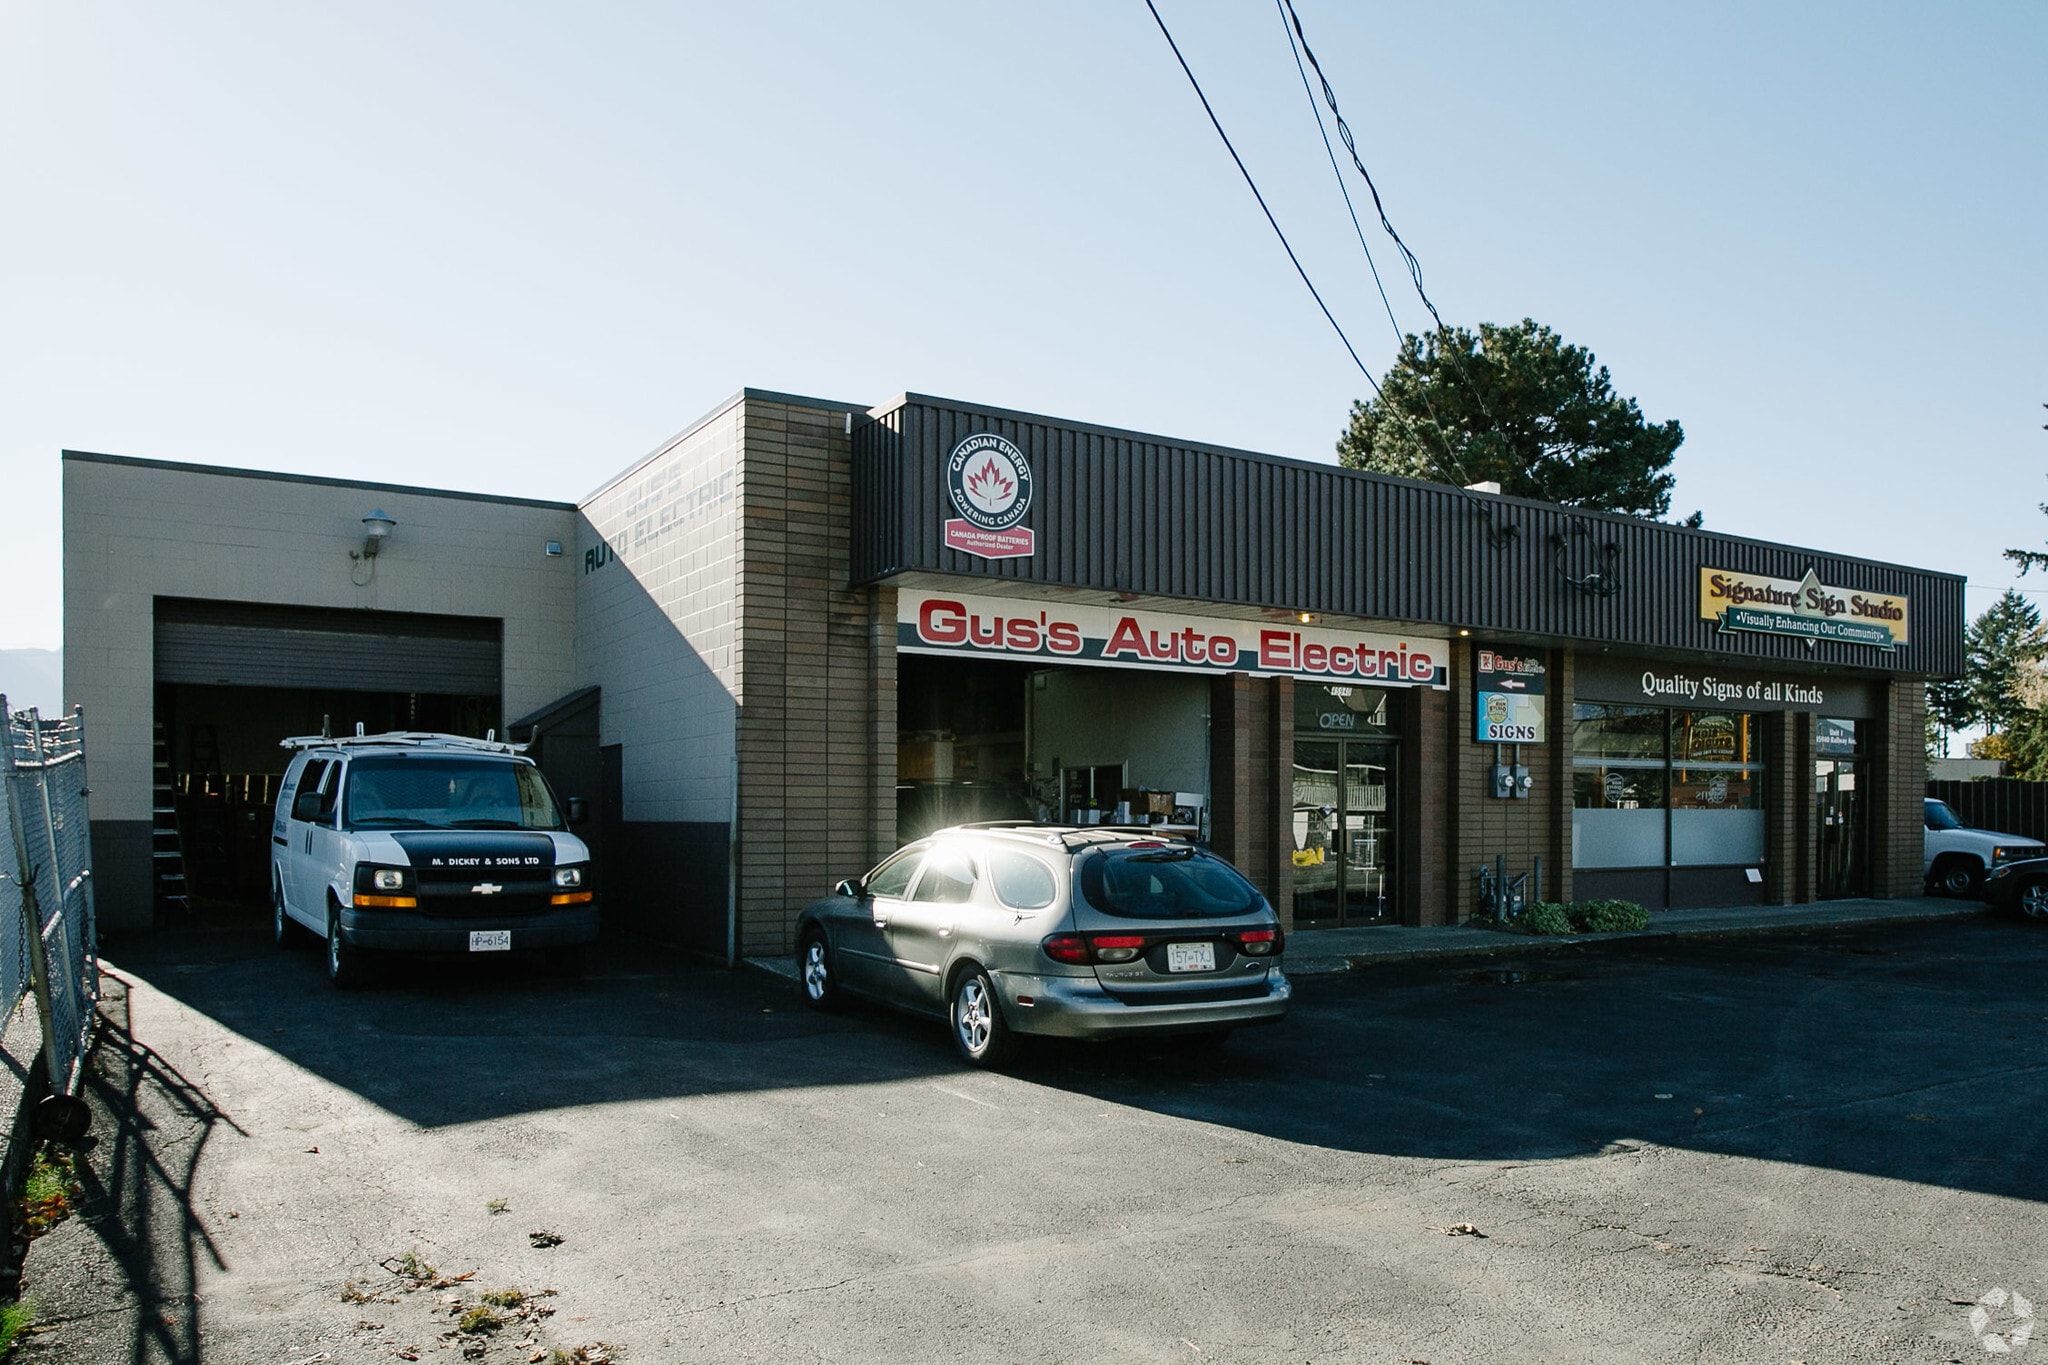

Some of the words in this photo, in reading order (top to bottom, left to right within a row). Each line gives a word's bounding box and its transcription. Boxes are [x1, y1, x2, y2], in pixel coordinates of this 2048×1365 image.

[952, 438, 997, 472] CANADIAN
[998, 442, 1029, 481] ENERGY
[953, 488, 995, 525] POWERING
[996, 498, 1027, 525] CANADA
[950, 530, 976, 539] CANADA
[976, 533, 997, 541] PROOF
[997, 535, 1029, 545] BATTERIES
[585, 530, 629, 575] AUTO
[1710, 574, 1801, 605] Signature
[1805, 588, 1847, 616] Sign
[1851, 595, 1904, 621] Studio
[918, 598, 1083, 654] Gus's
[1104, 616, 1239, 666] Auto
[1258, 629, 1435, 681] Electric
[1776, 616, 1820, 635] Enhancing
[1820, 622, 1836, 635] Our
[1837, 624, 1882, 642] Community
[1494, 655, 1523, 672] Gus's
[1642, 671, 1699, 699] Quality
[1703, 676, 1742, 701] Signs
[1746, 681, 1761, 700] of
[1764, 683, 1781, 701] all
[1785, 683, 1823, 704] Kinds
[1319, 713, 1355, 728] OPEN
[1489, 724, 1535, 739] SIGNS
[496, 857, 520, 865] SONS
[524, 857, 540, 865] LTD
